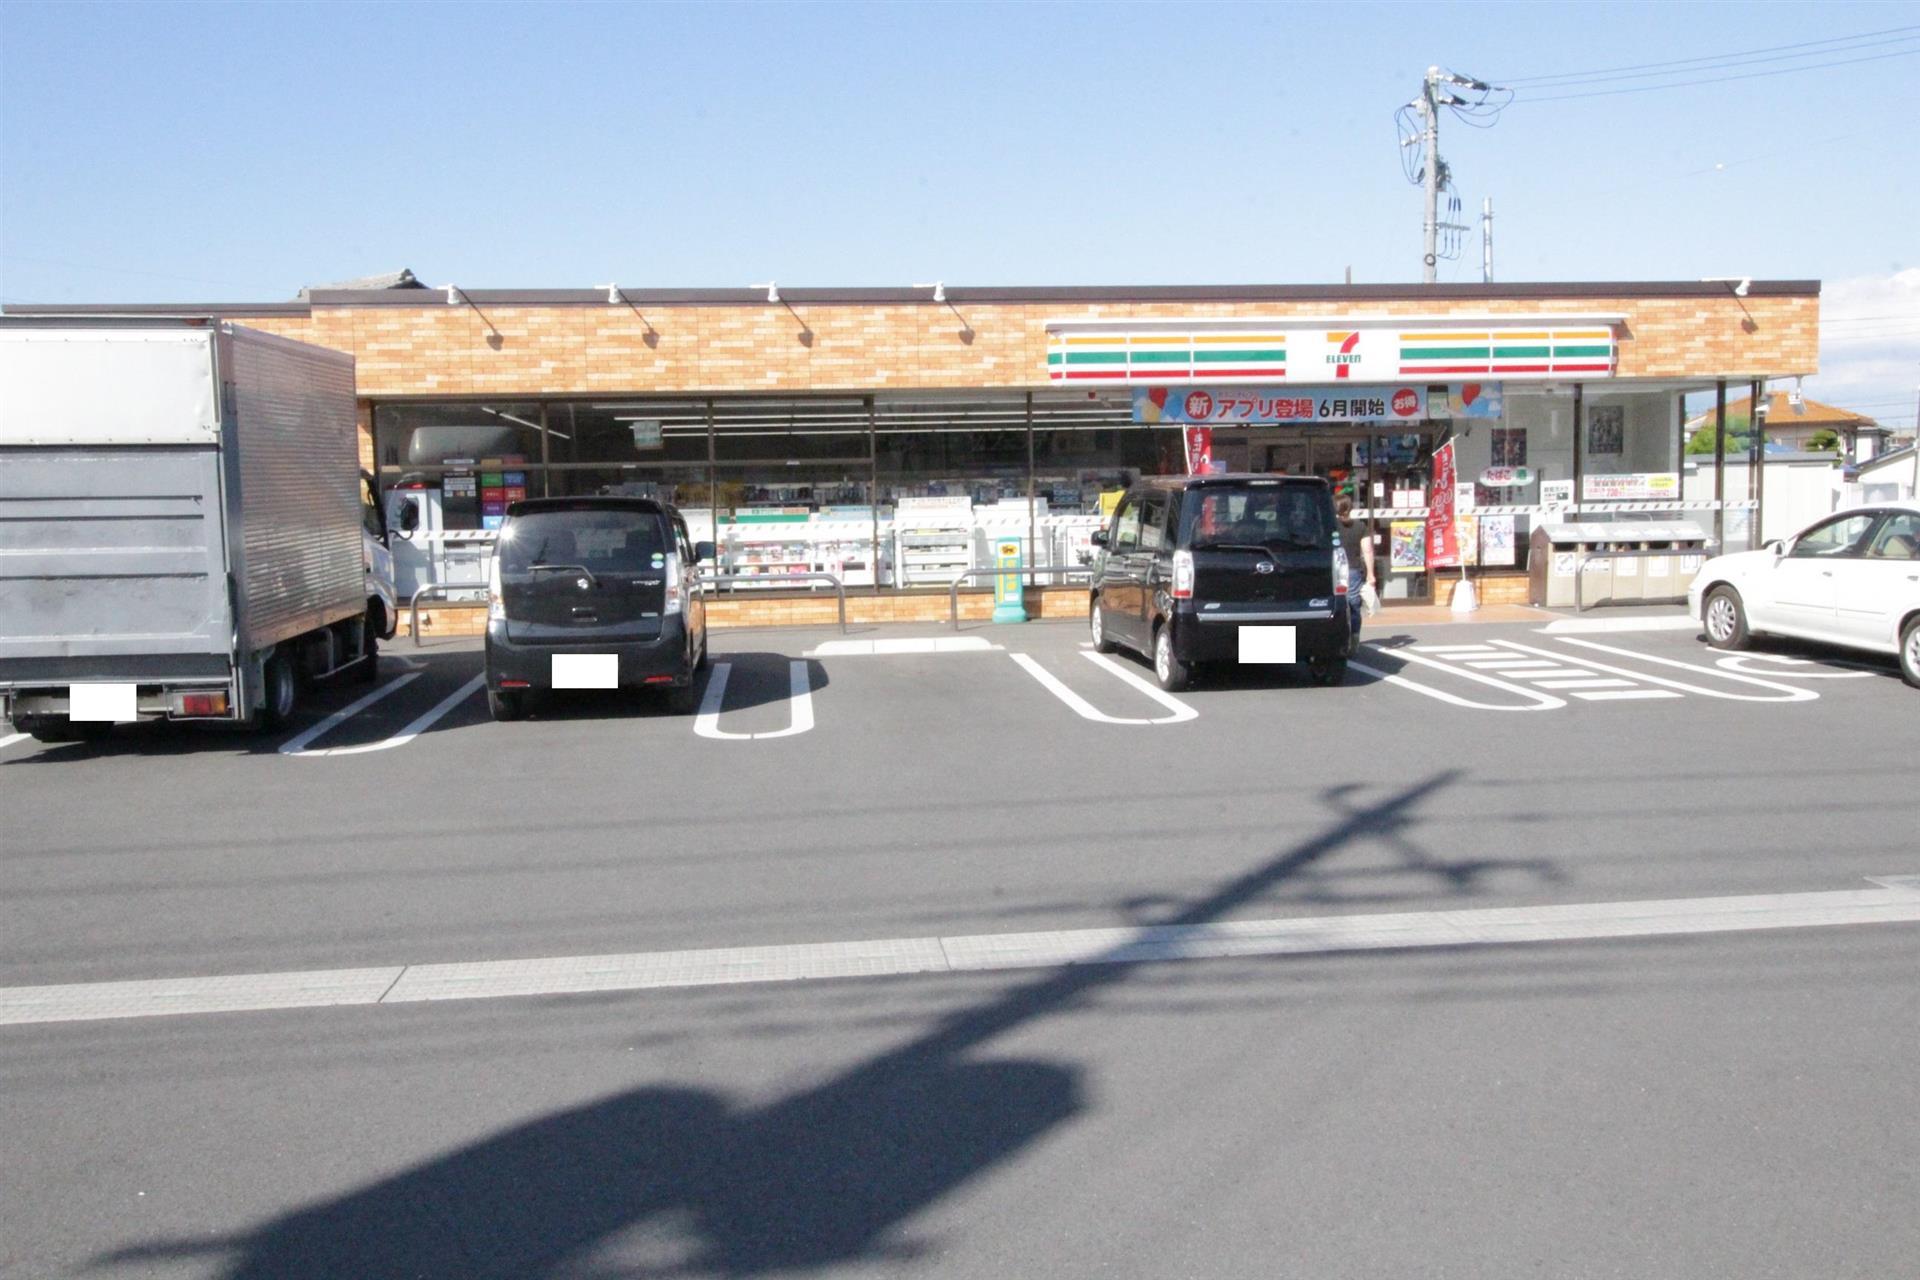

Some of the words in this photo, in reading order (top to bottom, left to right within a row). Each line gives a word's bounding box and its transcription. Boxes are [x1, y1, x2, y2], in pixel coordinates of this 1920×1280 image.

[1327, 331, 1359, 378] 7
[1189, 395, 1209, 416] 新
[1217, 396, 1313, 419] アプリ登場
[1319, 398, 1385, 418] 6月開始
[1393, 396, 1416, 410] お得
[1486, 469, 1512, 480] たばこ
